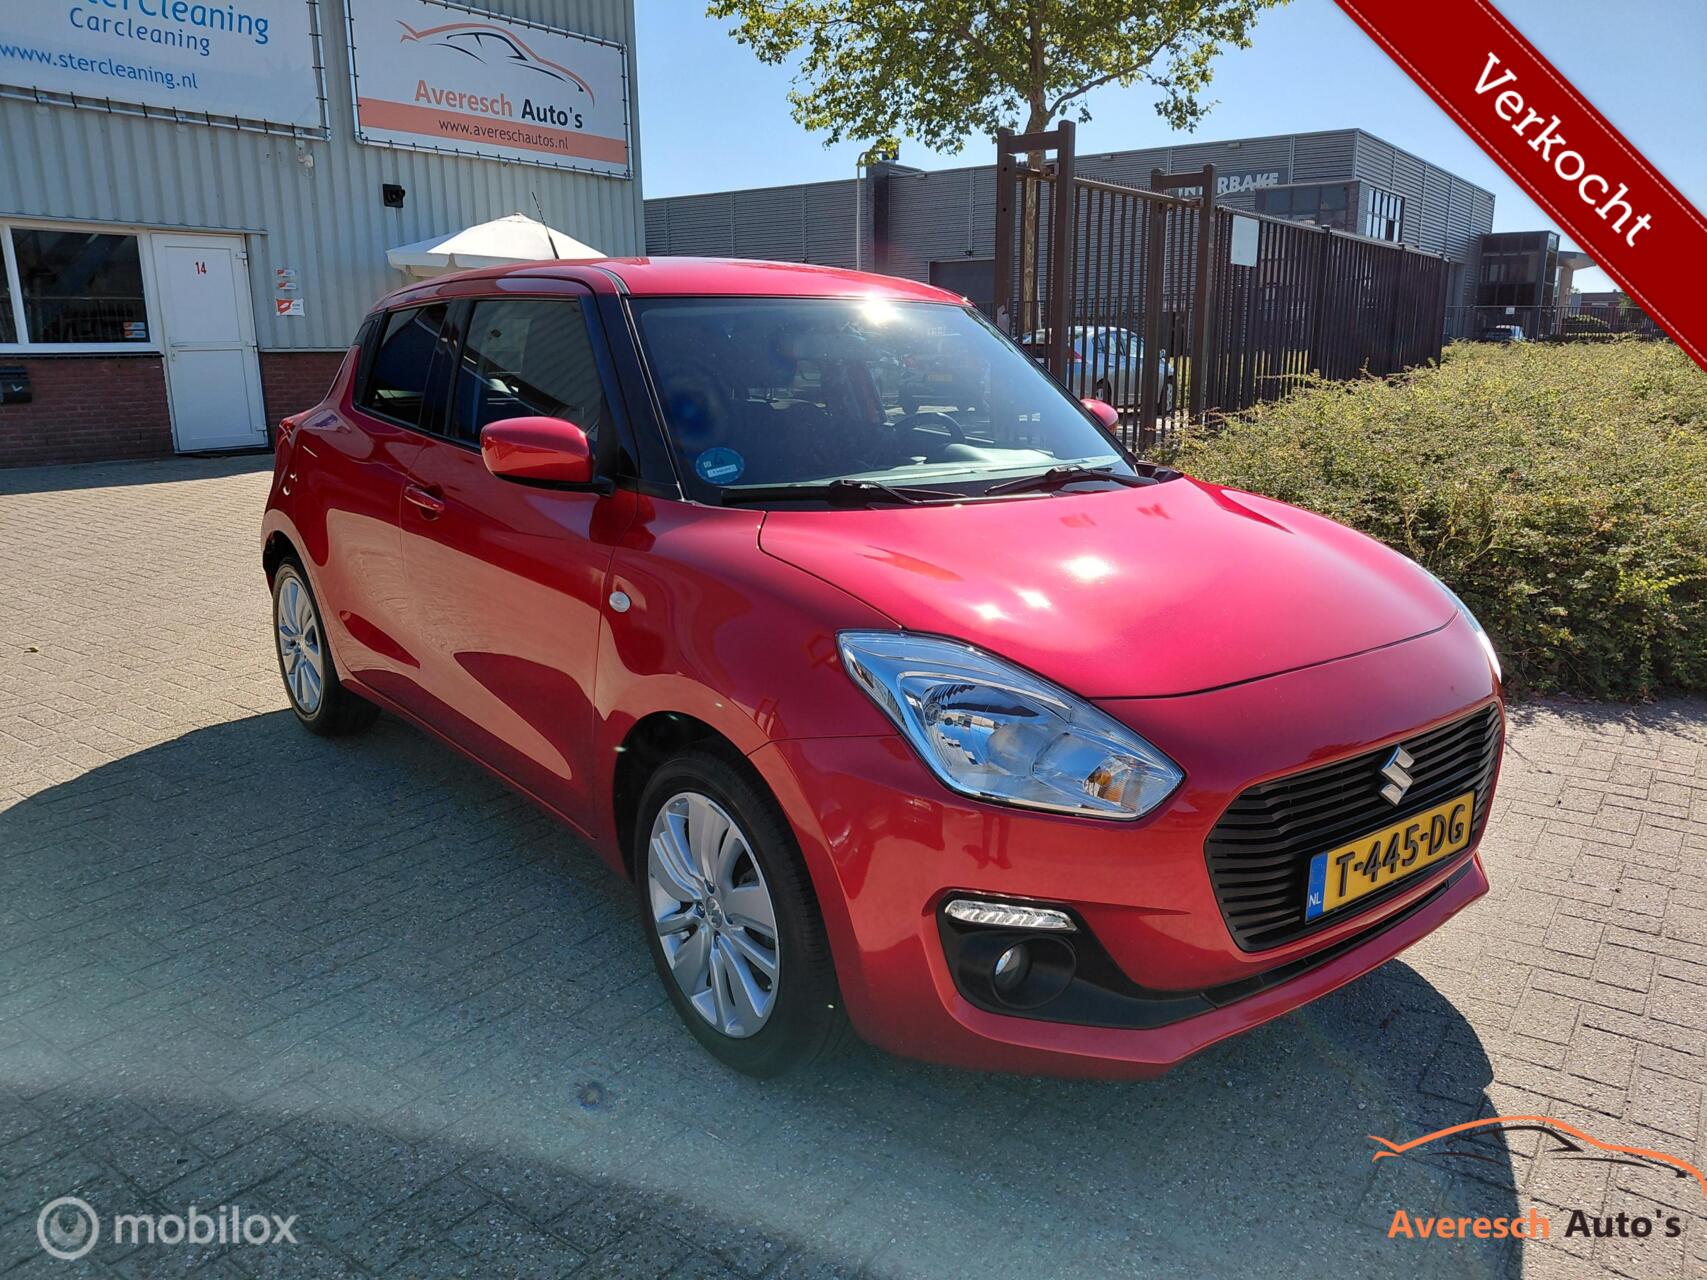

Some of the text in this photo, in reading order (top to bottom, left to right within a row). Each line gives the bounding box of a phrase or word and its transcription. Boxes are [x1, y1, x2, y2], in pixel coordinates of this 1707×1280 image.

[69, 7, 211, 57] Carcleaning
[0, 44, 199, 89] www.stercleaning.nl
[414, 79, 583, 129] Averesch Auto's
[438, 119, 569, 150] www.avereschautos.nl
[195, 261, 207, 275] 14
[1308, 803, 1466, 908] NL T-445-DG
